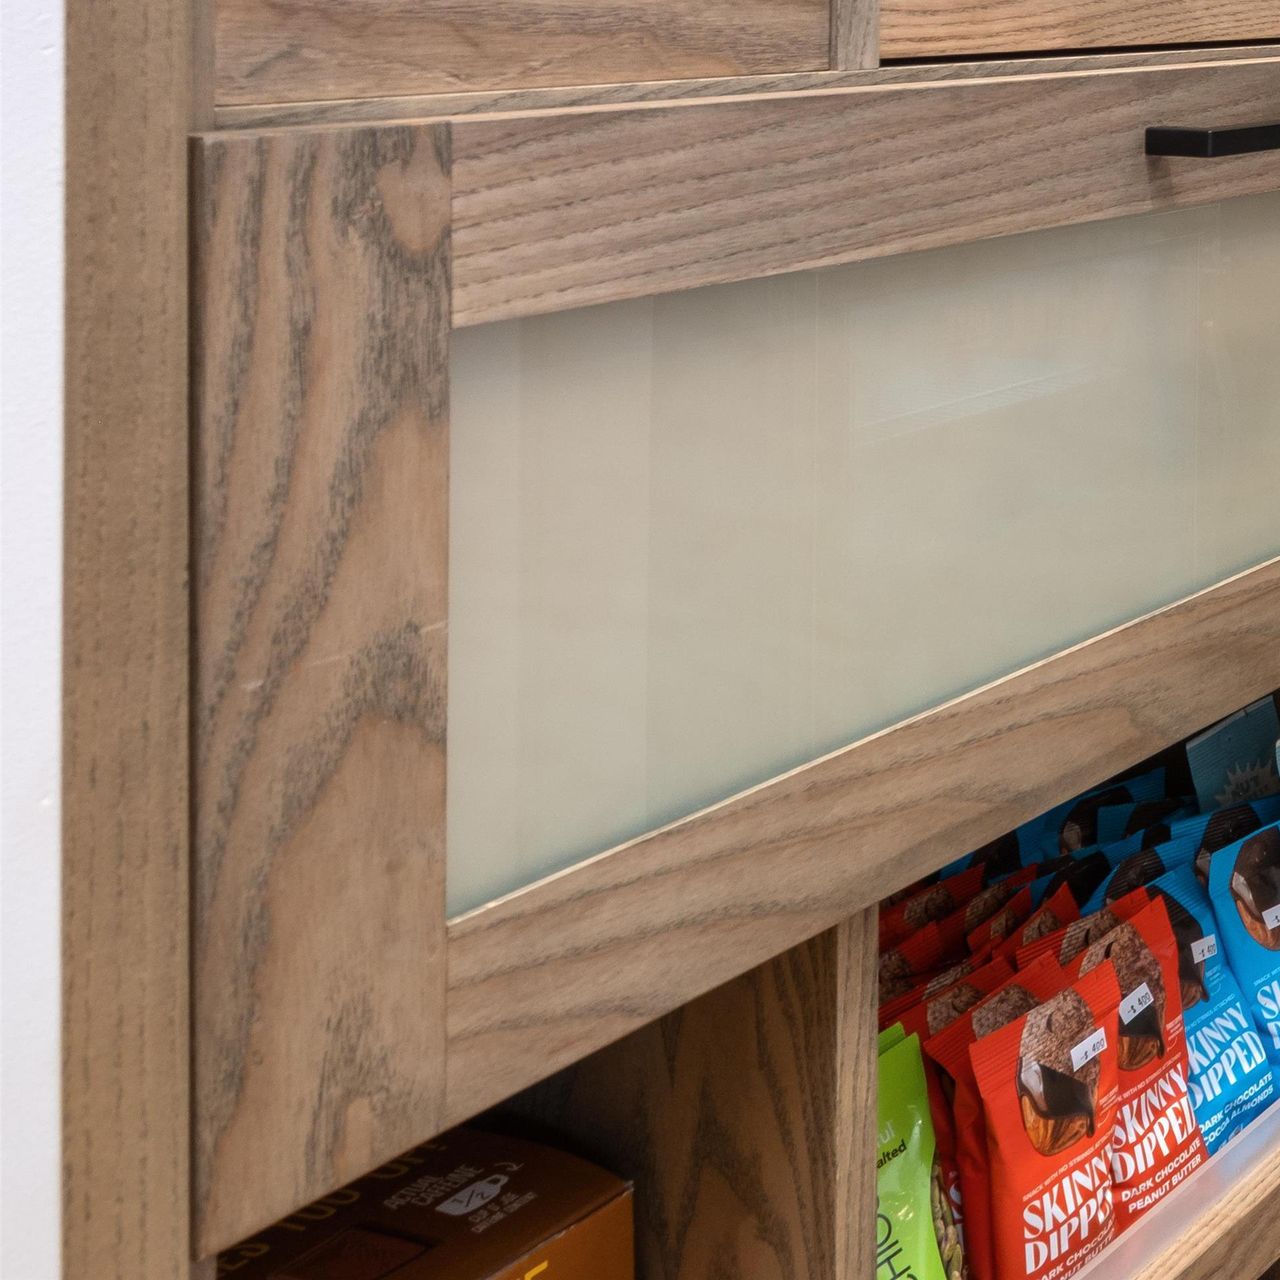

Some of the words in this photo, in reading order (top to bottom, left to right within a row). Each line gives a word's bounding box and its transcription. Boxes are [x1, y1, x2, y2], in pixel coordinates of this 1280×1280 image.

[1188, 1001, 1249, 1076] KINNY
[1224, 1072, 1273, 1114] CHOCOLATE
[1231, 1085, 1273, 1120] ALMONDS
[877, 1139, 907, 1170] alted
[1121, 1179, 1153, 1202] DARK
[1155, 1137, 1201, 1183] CHOCOLATE
[383, 1174, 448, 1210] ACTUAL
[415, 1163, 487, 1207] CAFFEINE
[1128, 1186, 1170, 1213] PEANUT
[1172, 1155, 1202, 1186] BUTTER
